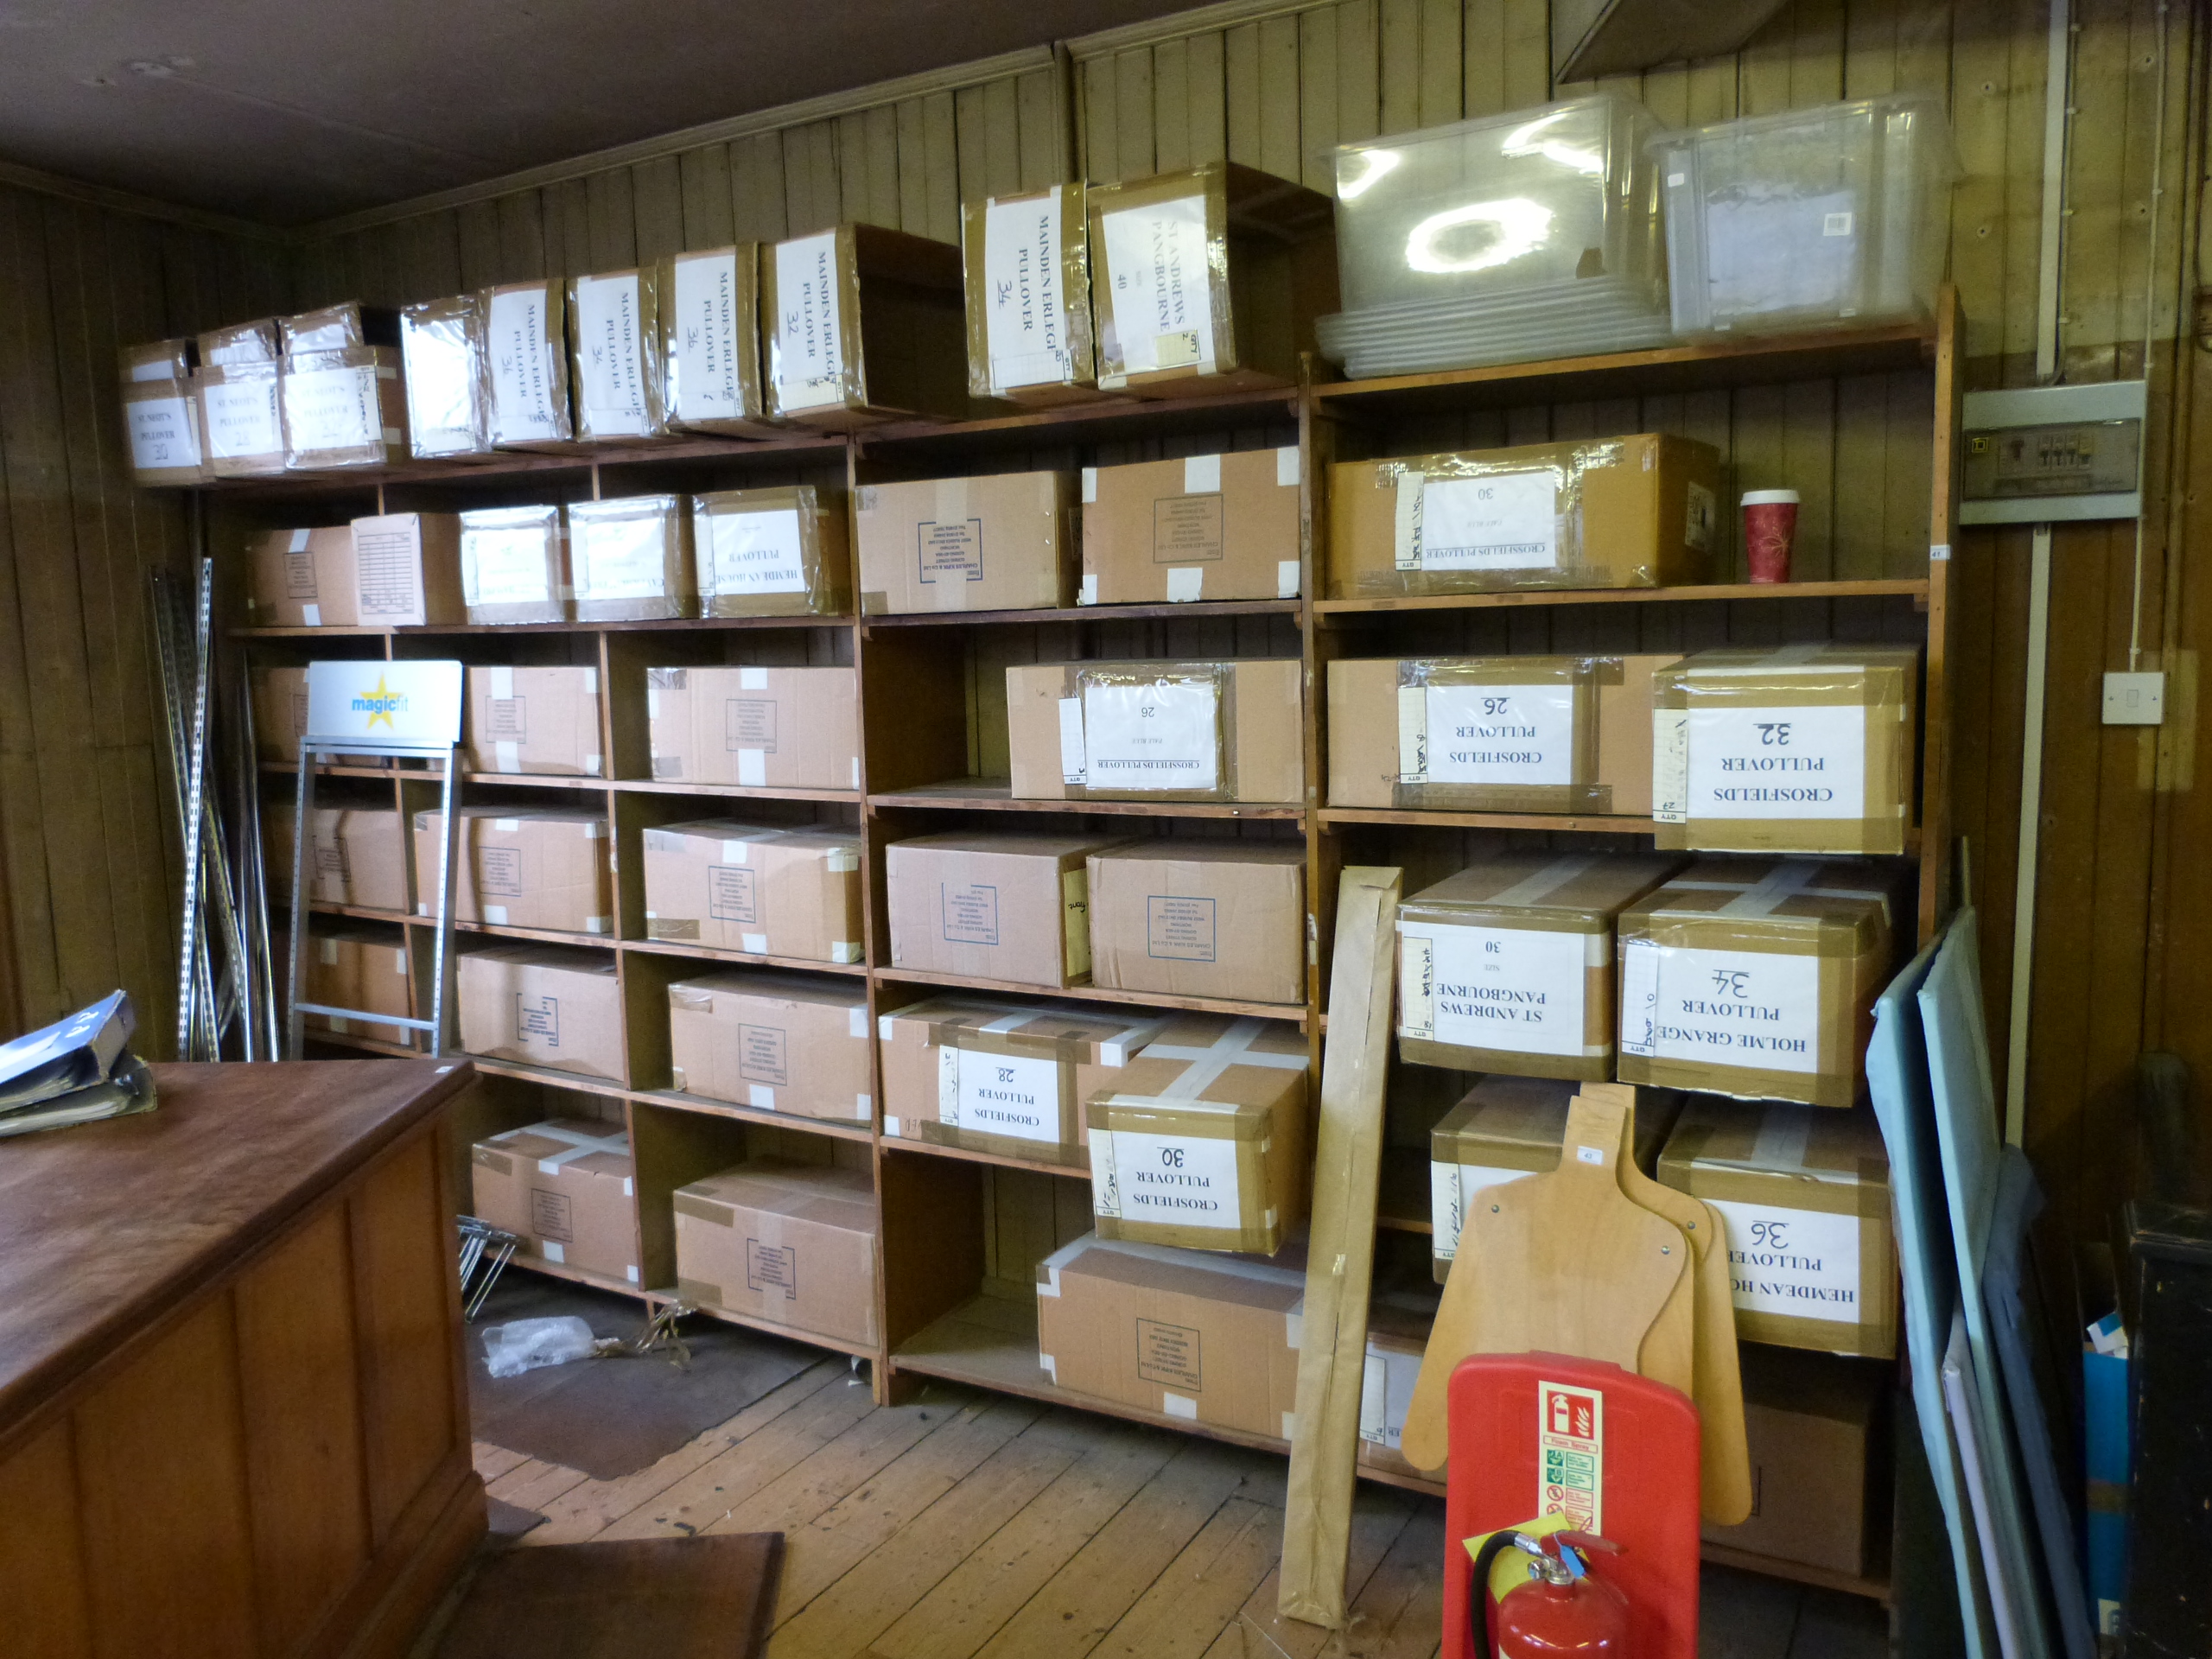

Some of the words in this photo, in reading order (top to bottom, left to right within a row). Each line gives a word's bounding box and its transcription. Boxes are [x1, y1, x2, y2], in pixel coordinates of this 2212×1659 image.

[1168, 221, 1178, 238] ST
[1039, 216, 1052, 288] MAINDEN
[818, 251, 830, 318] MAINDEN
[1117, 274, 1127, 289] 40
[1152, 221, 1170, 332] PANGBOURNE
[1169, 244, 1185, 324] ANDREWS
[997, 280, 1012, 308] 34
[1019, 248, 1033, 331] PULLOVER
[720, 272, 730, 335] MAINDEN
[621, 292, 632, 353] MAINDEN
[787, 311, 798, 338] 32
[803, 283, 815, 358] PULLOVER
[528, 305, 537, 363] MAINDEN
[687, 327, 698, 353] 36
[704, 301, 715, 373] PULLOVER
[1190, 334, 1198, 353] QTY
[514, 331, 527, 397] PULLOVER
[607, 320, 620, 389] PULLOVER
[502, 356, 513, 378] 36
[304, 405, 348, 416] PULLOVER
[220, 416, 260, 426] PULLOVER
[141, 431, 175, 441] PULLOVER
[1478, 488, 1493, 499] 30
[728, 550, 779, 562] PULLOVER
[1427, 549, 1476, 558] PULLOVER
[1478, 543, 1545, 556] CROSSFIELDS
[715, 574, 746, 584] HOUSE
[748, 569, 798, 582] HEMDEAN
[352, 696, 409, 715] magicfit
[1141, 707, 1154, 717] 26
[1481, 696, 1511, 715] 26
[1455, 726, 1536, 739] PULLOVER
[1752, 722, 1792, 746] 32
[1097, 760, 1141, 769] PULLOVER
[1142, 760, 1200, 769] CROSSFIELDS
[1449, 750, 1542, 765] CROSFIELDS
[1720, 757, 1825, 772] PULLOVER
[1713, 787, 1834, 803] CROSFIELDS
[1485, 941, 1501, 953] 30
[1437, 983, 1546, 1004] PANGBOURNE
[1711, 969, 1751, 1000] 34
[1440, 1001, 1518, 1020] ANDREWS
[1522, 1010, 1542, 1022] ST
[1681, 999, 1780, 1021] PULLOVER
[1656, 1025, 1732, 1046] GRANGE
[1737, 1033, 1807, 1053] HOLME
[995, 1066, 1016, 1083] 28
[978, 1088, 1035, 1105] PULLOVER
[974, 1108, 1040, 1127] CROSFIELDS
[1157, 1147, 1185, 1168] 30
[1136, 1170, 1211, 1187] PULLOVER
[1133, 1192, 1219, 1211] CROSFIELDS
[1751, 1220, 1789, 1249] 36
[1760, 1282, 1854, 1302] HEMDEAN
[1174, 1370, 1198, 1378] CHARLES
[1551, 1437, 1568, 1448] Foam
[1571, 1440, 1589, 1452] Spray
